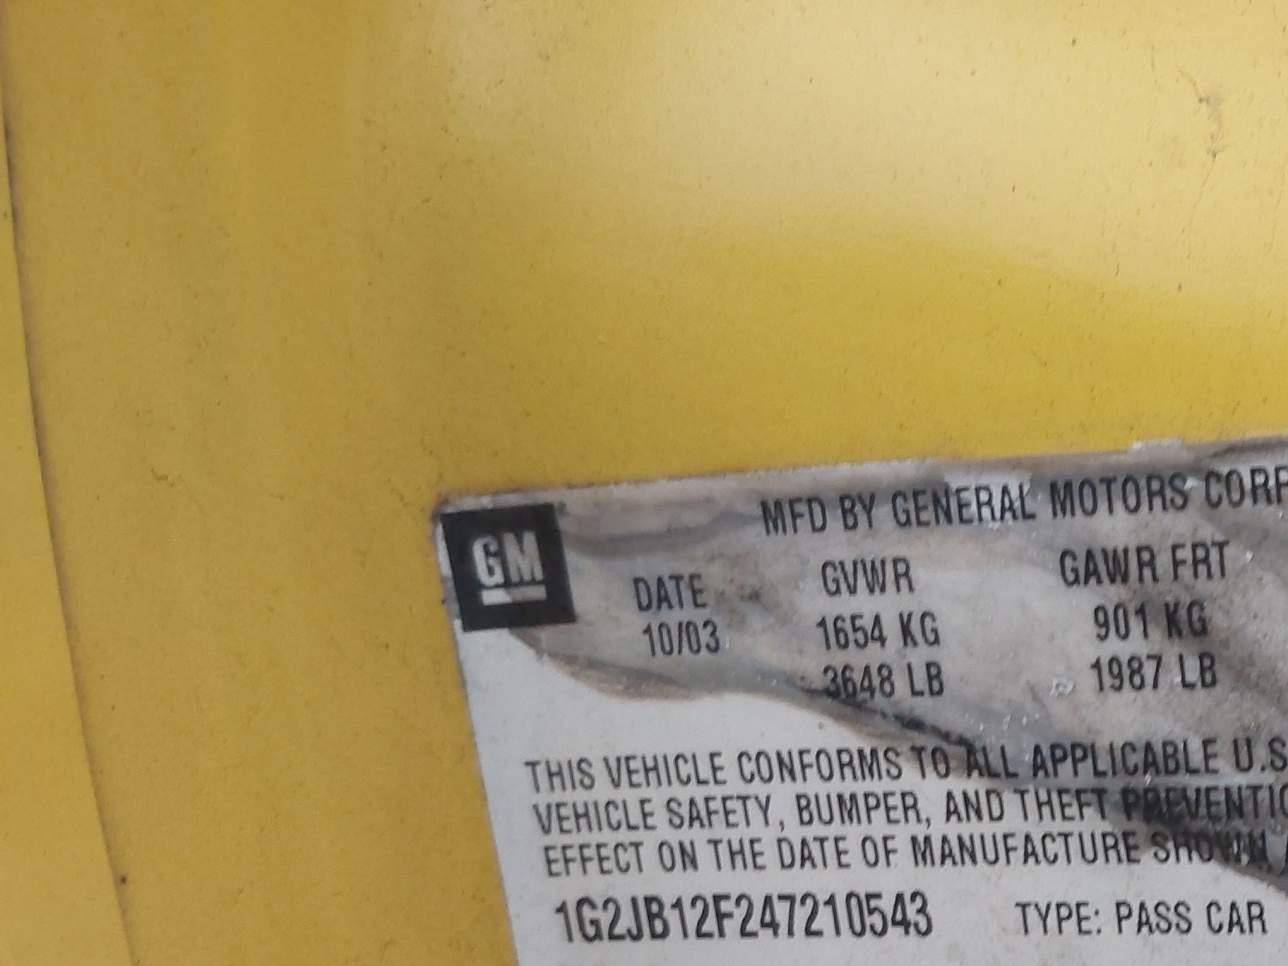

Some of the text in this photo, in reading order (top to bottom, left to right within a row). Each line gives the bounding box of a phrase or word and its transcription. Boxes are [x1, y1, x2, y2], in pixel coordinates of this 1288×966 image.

[761, 499, 827, 536] MFD
[841, 495, 876, 530] BY
[891, 483, 1037, 527] GENERAL
[1051, 474, 1188, 519] MOTORS
[472, 531, 547, 586] GM
[821, 557, 914, 596] GVWR
[1060, 541, 1230, 586] GAWR FRT
[634, 575, 706, 612] DATE
[643, 621, 721, 657] 10/03
[816, 610, 939, 650] 1654 KG
[1093, 601, 1208, 641] 901 KG
[822, 662, 944, 699] 3648 LB
[1091, 655, 1216, 693] 1987 LB
[525, 759, 595, 793] THIS
[603, 752, 725, 789] VEHICLE
[737, 748, 901, 784] CONFORMS
[910, 746, 950, 779] TO
[967, 746, 1018, 779] ALL
[1031, 738, 1218, 778] APPLICABLE
[533, 797, 657, 836] VEHICLE
[668, 794, 785, 831] SAFETY,
[798, 791, 932, 827] BUMPER,
[944, 790, 1007, 823] AND
[1015, 787, 1107, 821] THEFT
[545, 840, 645, 878] EFFECT
[659, 839, 698, 873] ON
[707, 838, 768, 871] THE
[779, 836, 851, 870] DATE
[861, 835, 899, 867] OF
[910, 831, 1140, 869] MANUFACTURE
[554, 890, 933, 943] 1G2JB12F247210543
[1015, 900, 1268, 936] TYPE: PASS CAR
